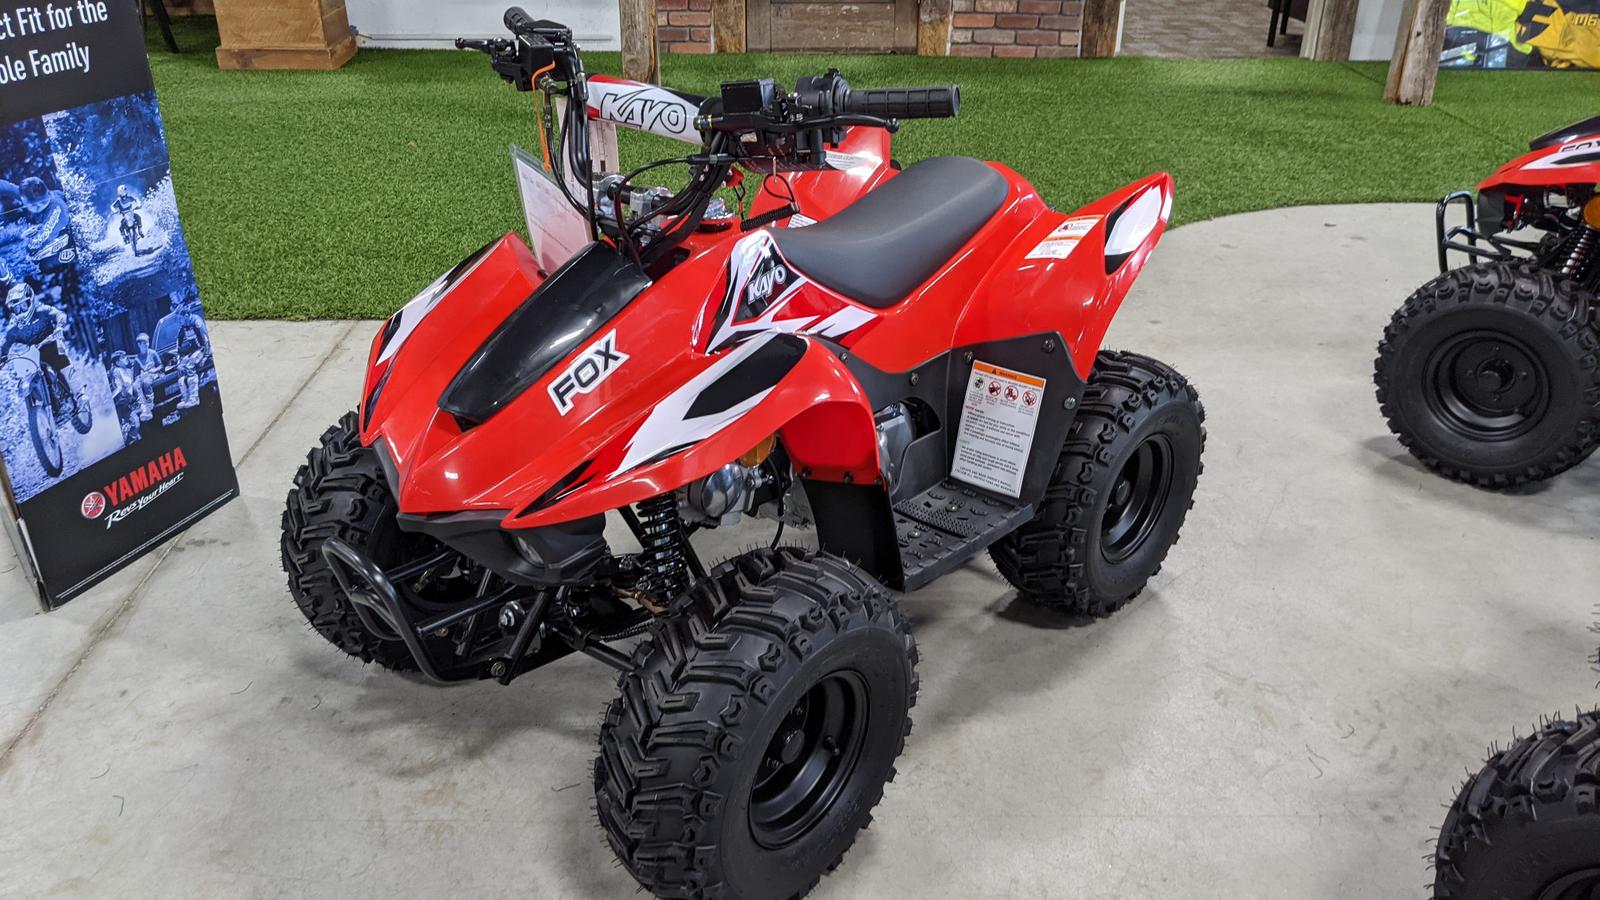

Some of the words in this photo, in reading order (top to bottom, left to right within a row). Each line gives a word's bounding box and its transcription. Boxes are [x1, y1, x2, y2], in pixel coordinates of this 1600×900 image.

[16, 7, 45, 36] Fit
[46, 2, 73, 30] for
[77, 0, 108, 24] the
[28, 41, 90, 76] Family
[600, 92, 687, 134] KAYO
[552, 339, 621, 408] FOX
[103, 447, 188, 507] YAMAHA
[104, 500, 138, 530] Revs
[136, 488, 160, 511] Your
[158, 472, 184, 494] Heart
